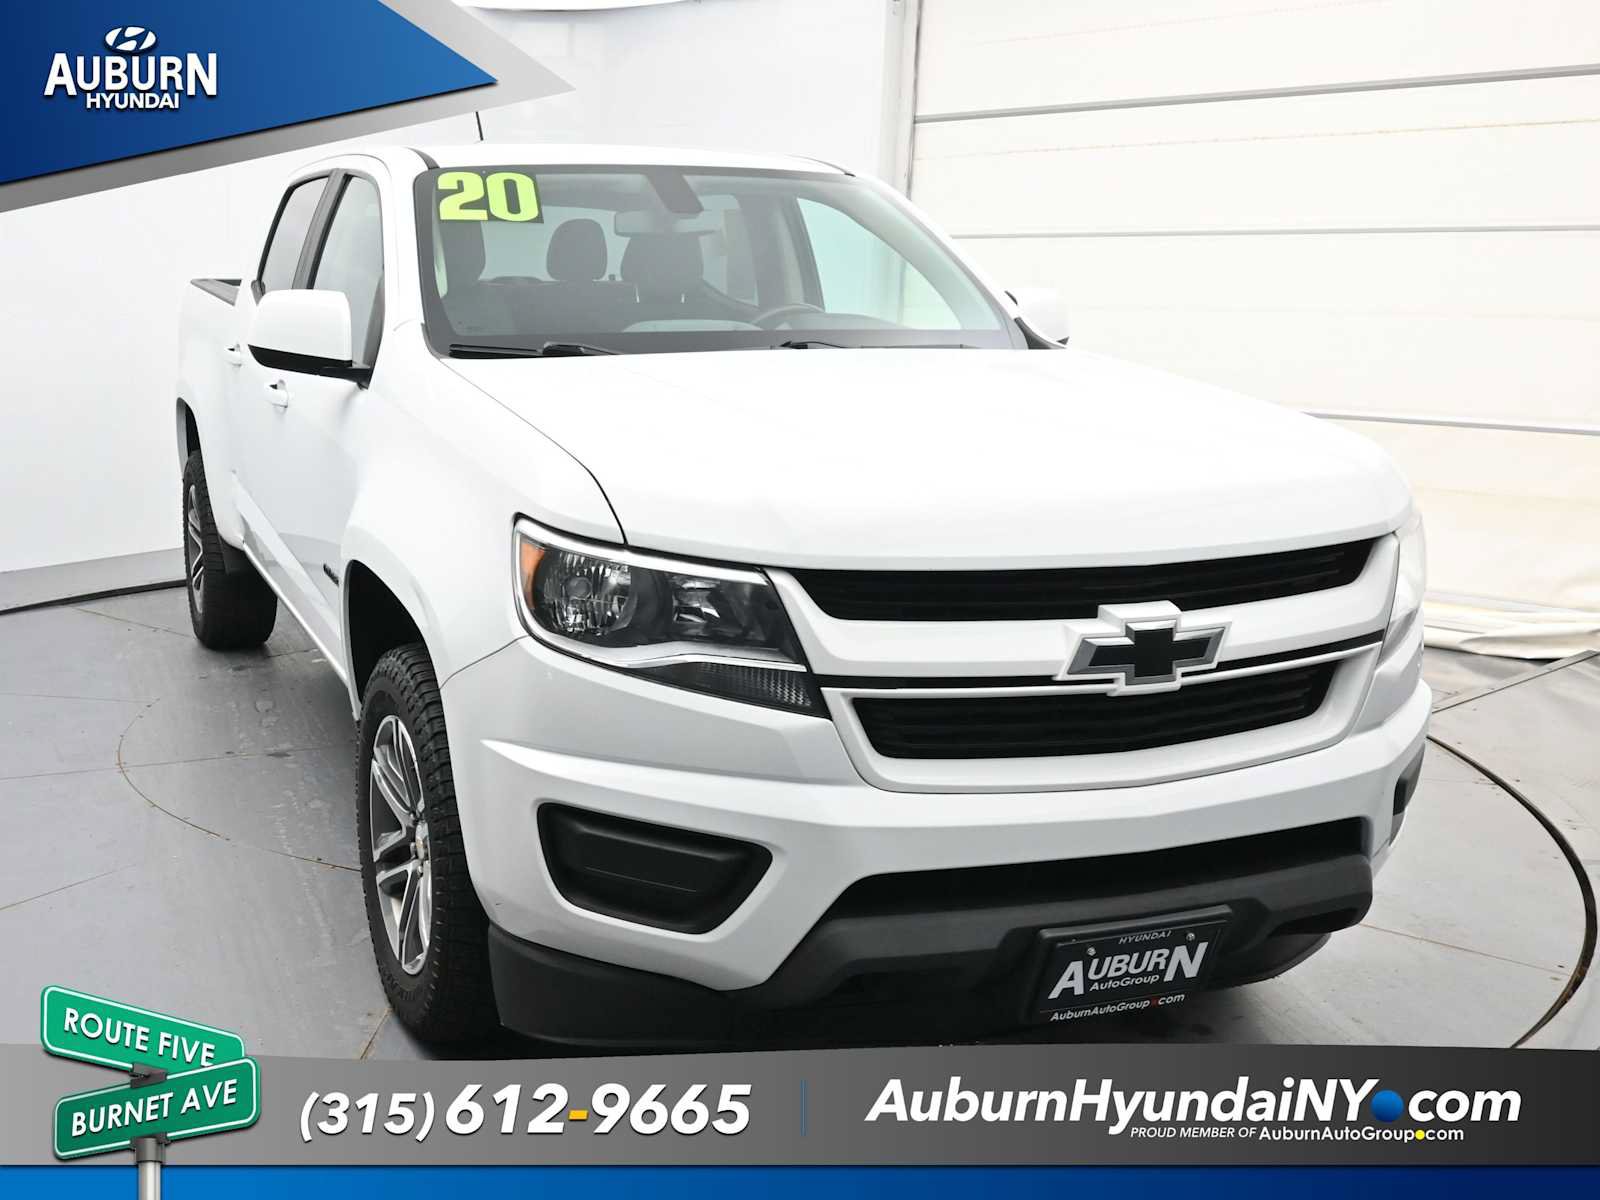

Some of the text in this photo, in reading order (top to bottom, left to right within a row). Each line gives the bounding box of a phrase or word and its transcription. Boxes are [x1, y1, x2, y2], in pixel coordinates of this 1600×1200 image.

[437, 171, 539, 222] 20
[1118, 930, 1172, 945] HYUNDAI
[1048, 941, 1209, 1000] AUBURN
[1089, 974, 1160, 992] AutoGroup
